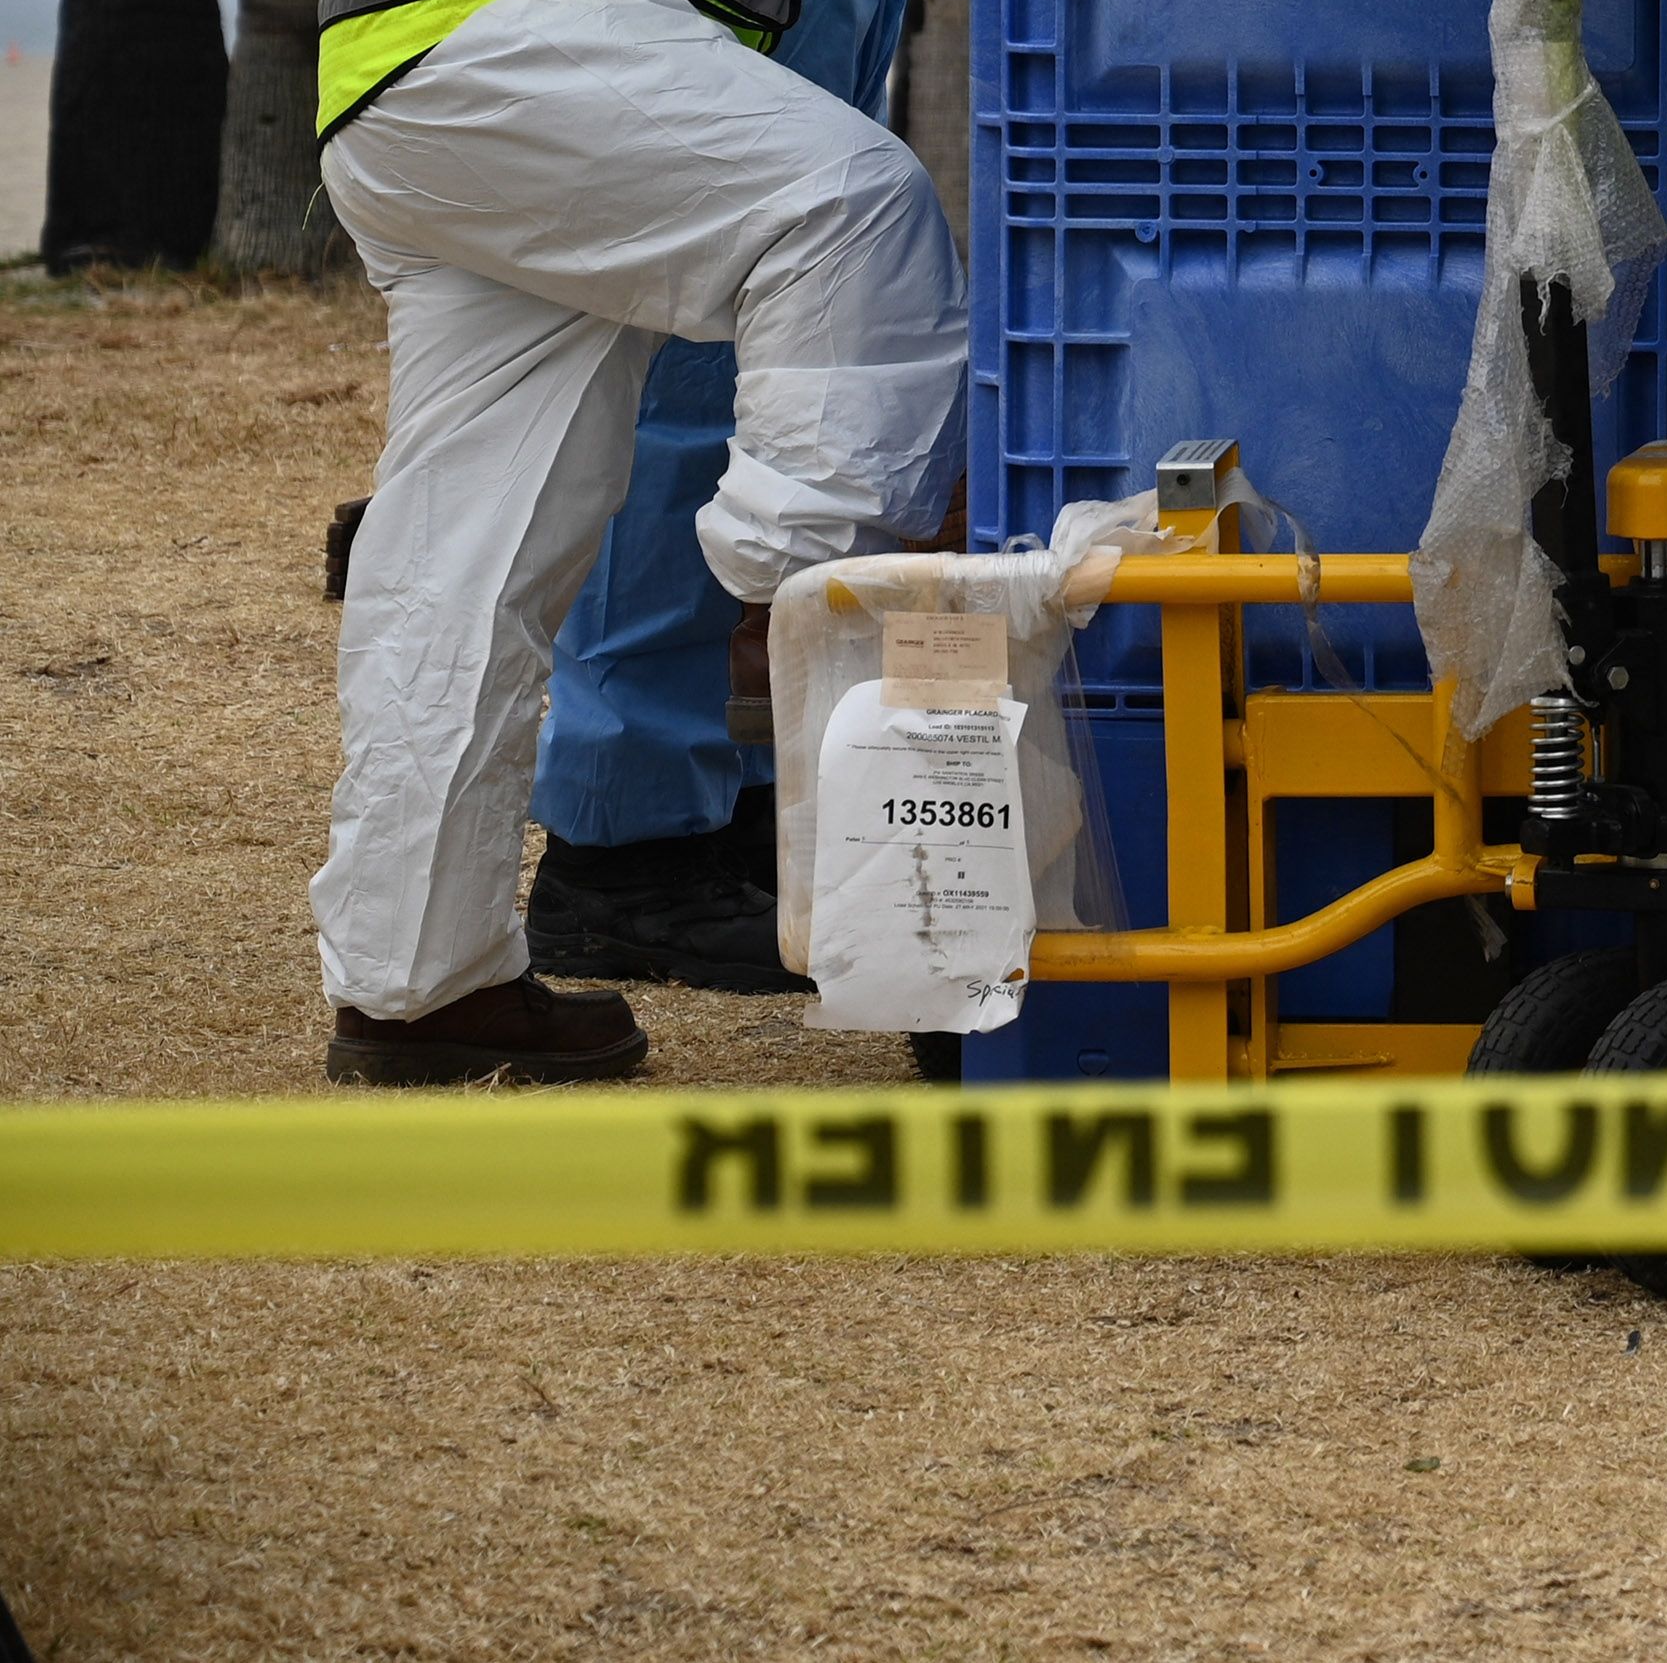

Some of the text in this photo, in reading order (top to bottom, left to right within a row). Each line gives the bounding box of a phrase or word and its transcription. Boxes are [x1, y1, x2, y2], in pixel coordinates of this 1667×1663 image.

[965, 709, 999, 717] PLACARD
[956, 735, 989, 743] VESTIL
[882, 798, 1010, 829] 1353861
